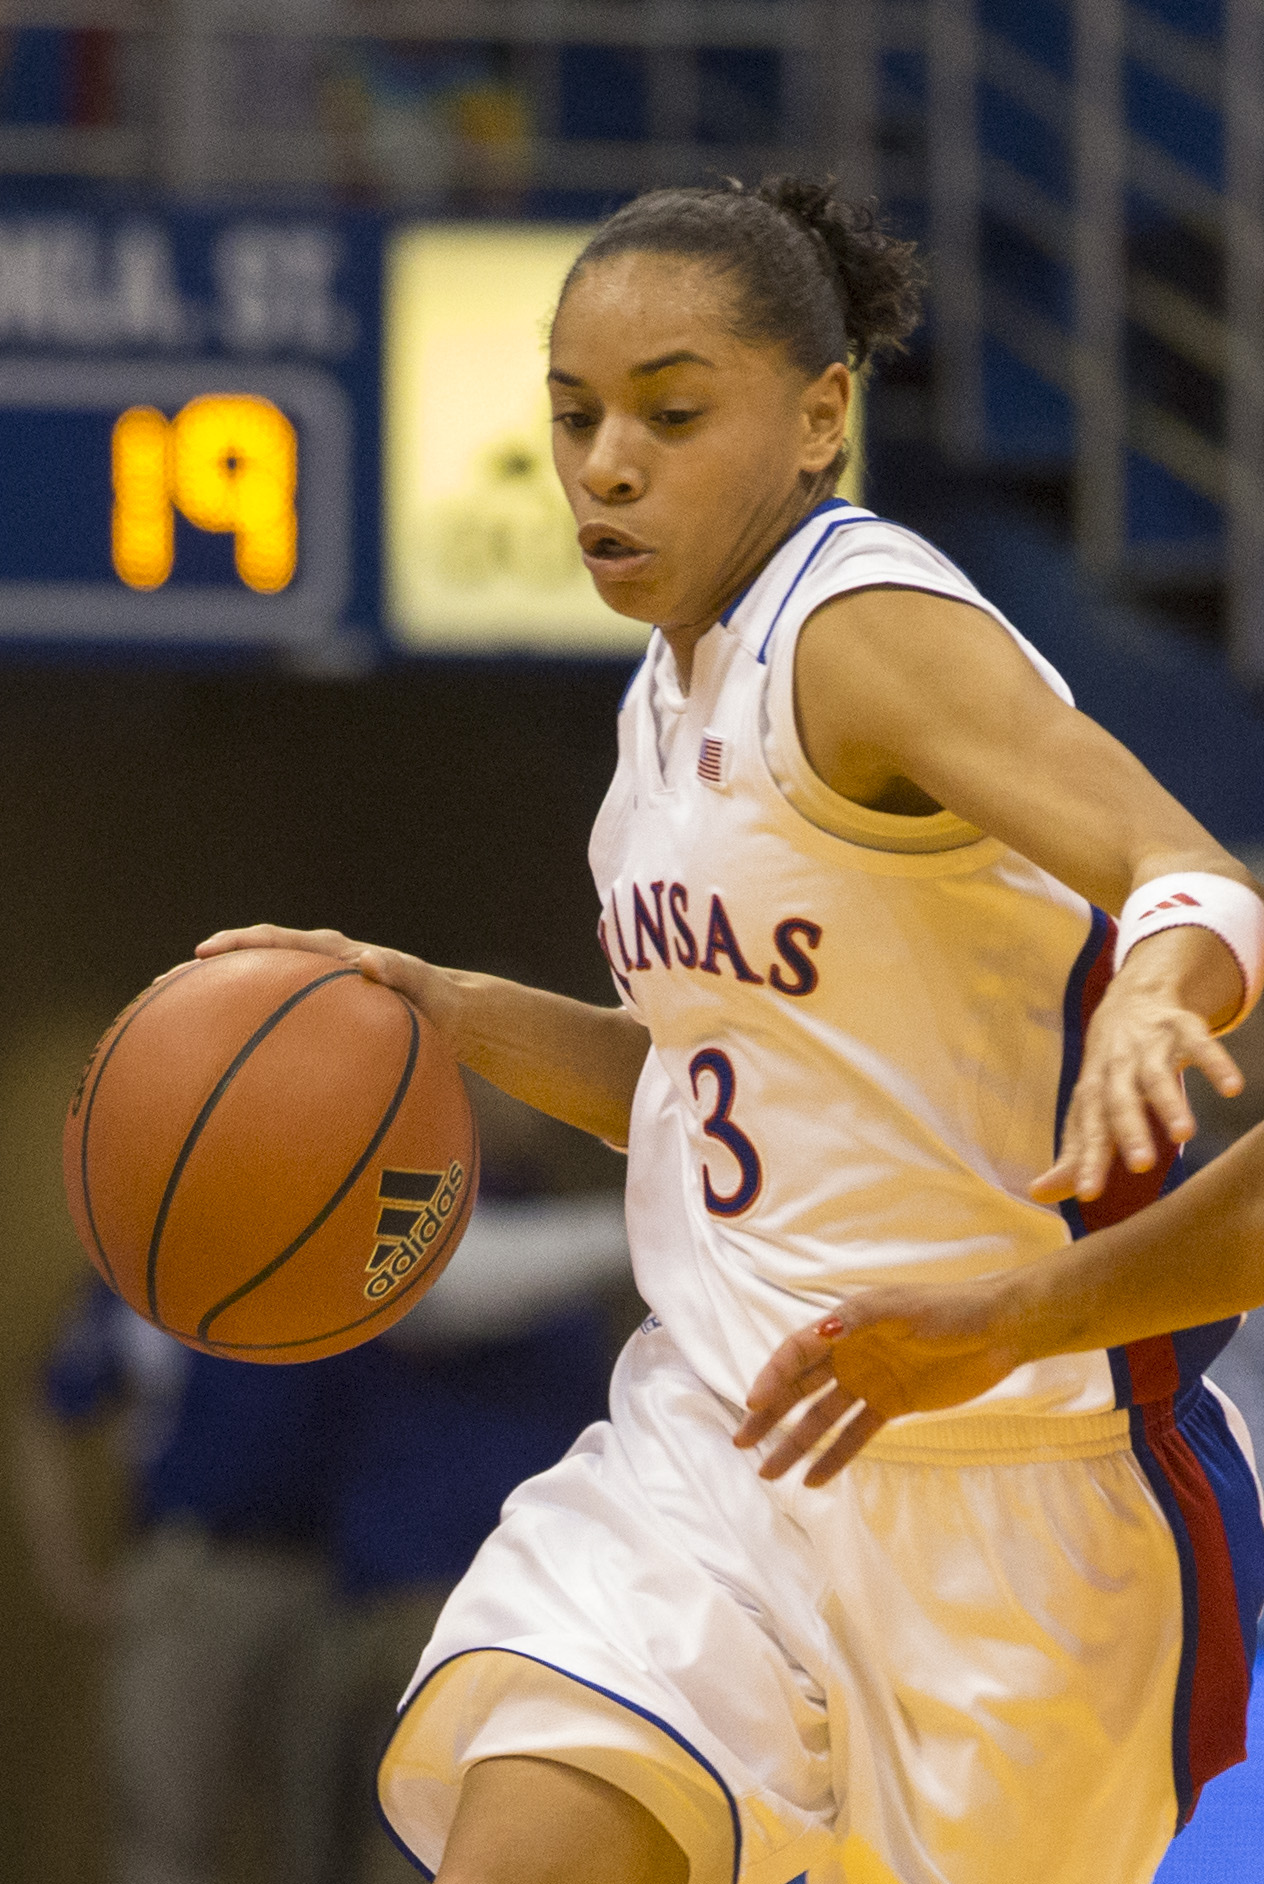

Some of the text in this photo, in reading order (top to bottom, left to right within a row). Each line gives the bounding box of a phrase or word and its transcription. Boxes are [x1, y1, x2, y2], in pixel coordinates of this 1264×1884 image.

[112, 393, 298, 594] 19
[688, 1047, 763, 1219] 3
[364, 1161, 463, 1300] adidas
